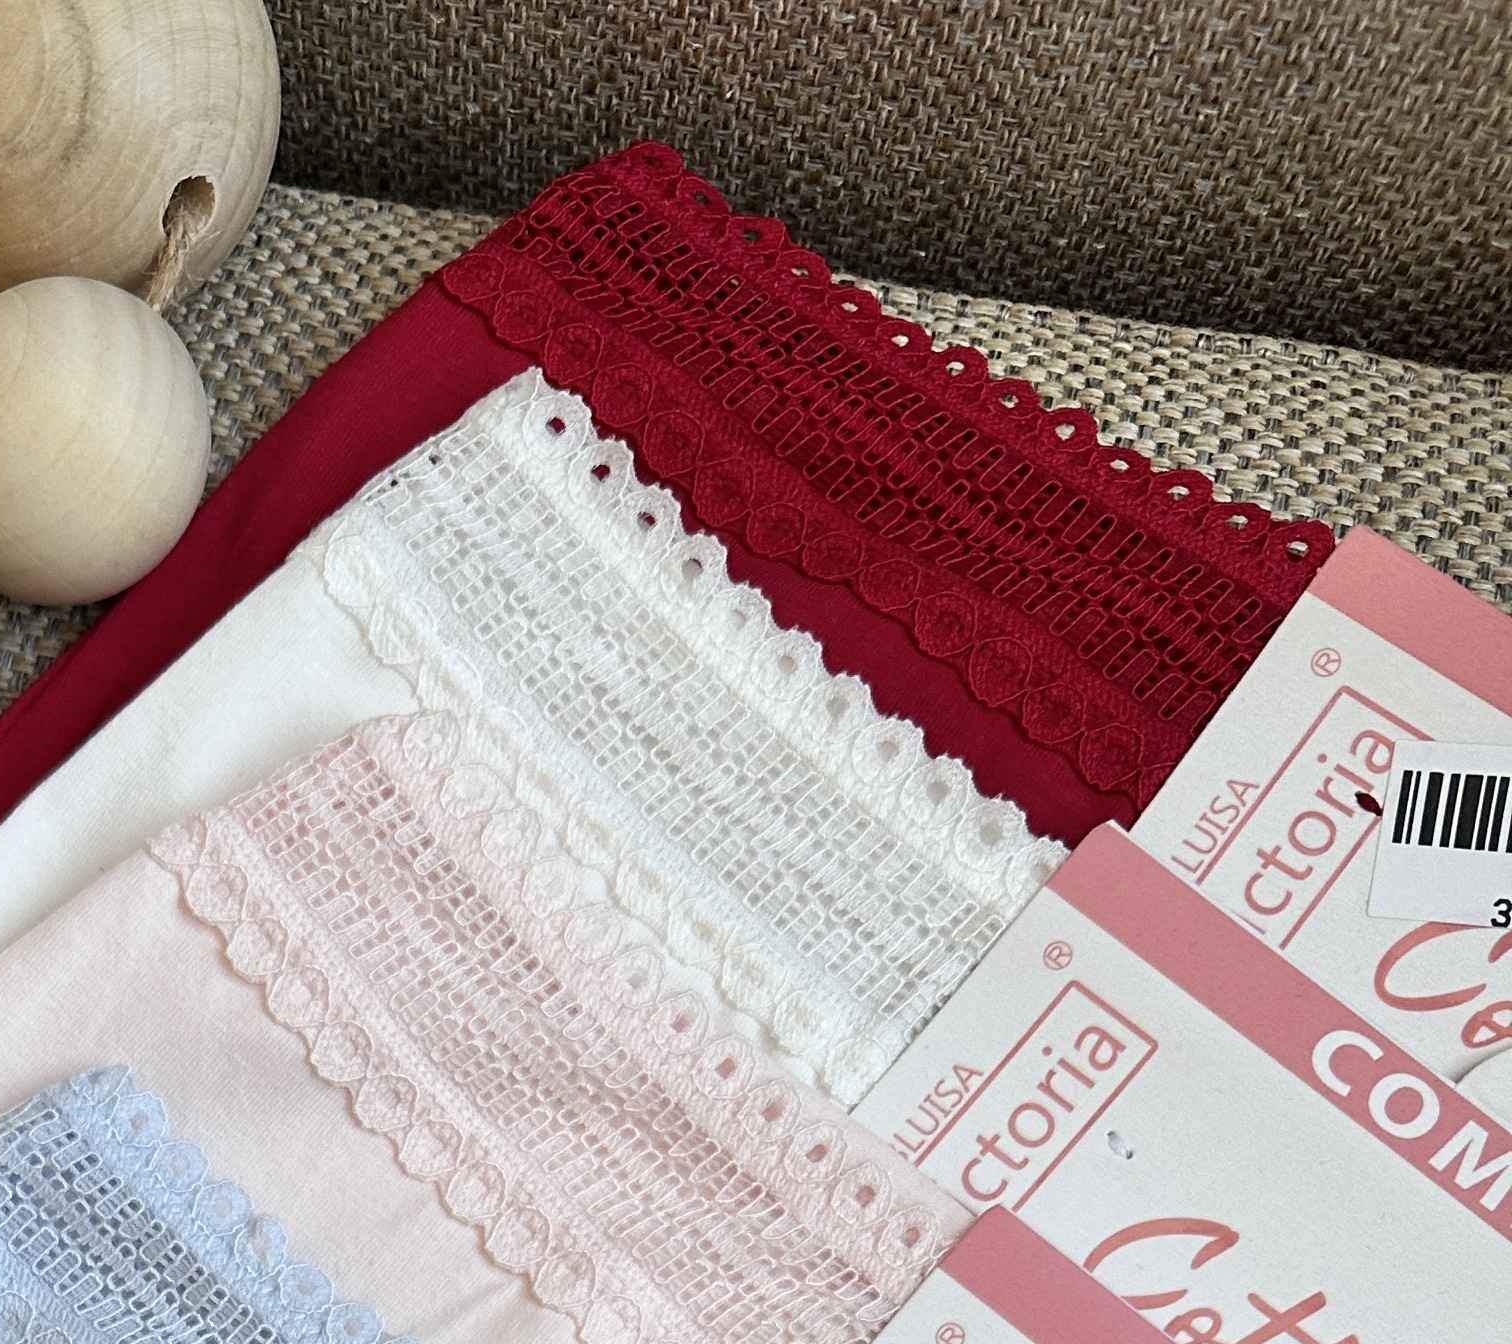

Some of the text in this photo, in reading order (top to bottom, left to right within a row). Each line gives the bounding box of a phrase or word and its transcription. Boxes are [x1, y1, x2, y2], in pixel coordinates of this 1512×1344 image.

[1171, 777, 1260, 875] LUISA
[1243, 728, 1396, 917] ctoria
[890, 1064, 984, 1160] LUISA
[961, 1025, 1127, 1202] ctoria
[1312, 1030, 1512, 1212] COM
